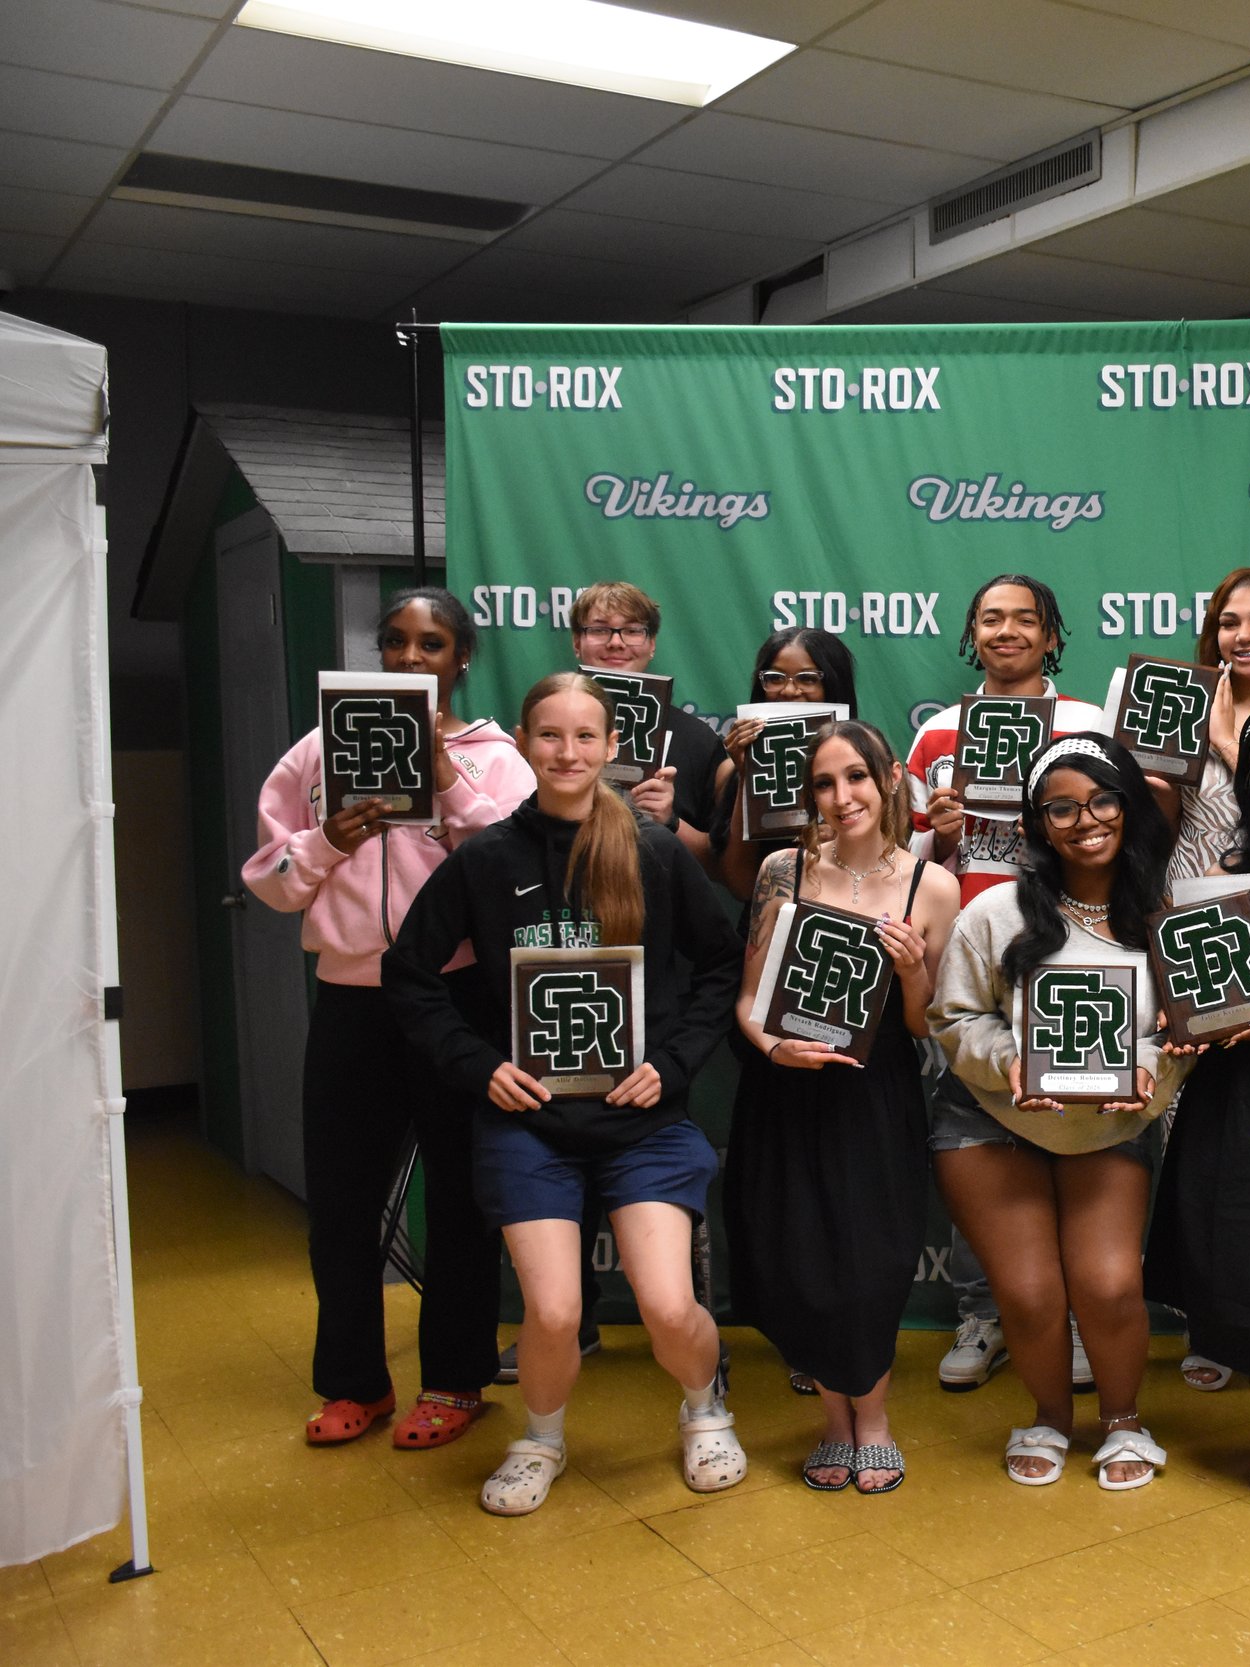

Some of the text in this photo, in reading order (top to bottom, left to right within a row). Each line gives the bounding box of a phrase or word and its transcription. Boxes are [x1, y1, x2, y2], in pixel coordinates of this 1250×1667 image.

[585, 472, 769, 529] Vikings
[908, 474, 1103, 531] Vikings
[814, 1022, 847, 1037] Rodriguez
